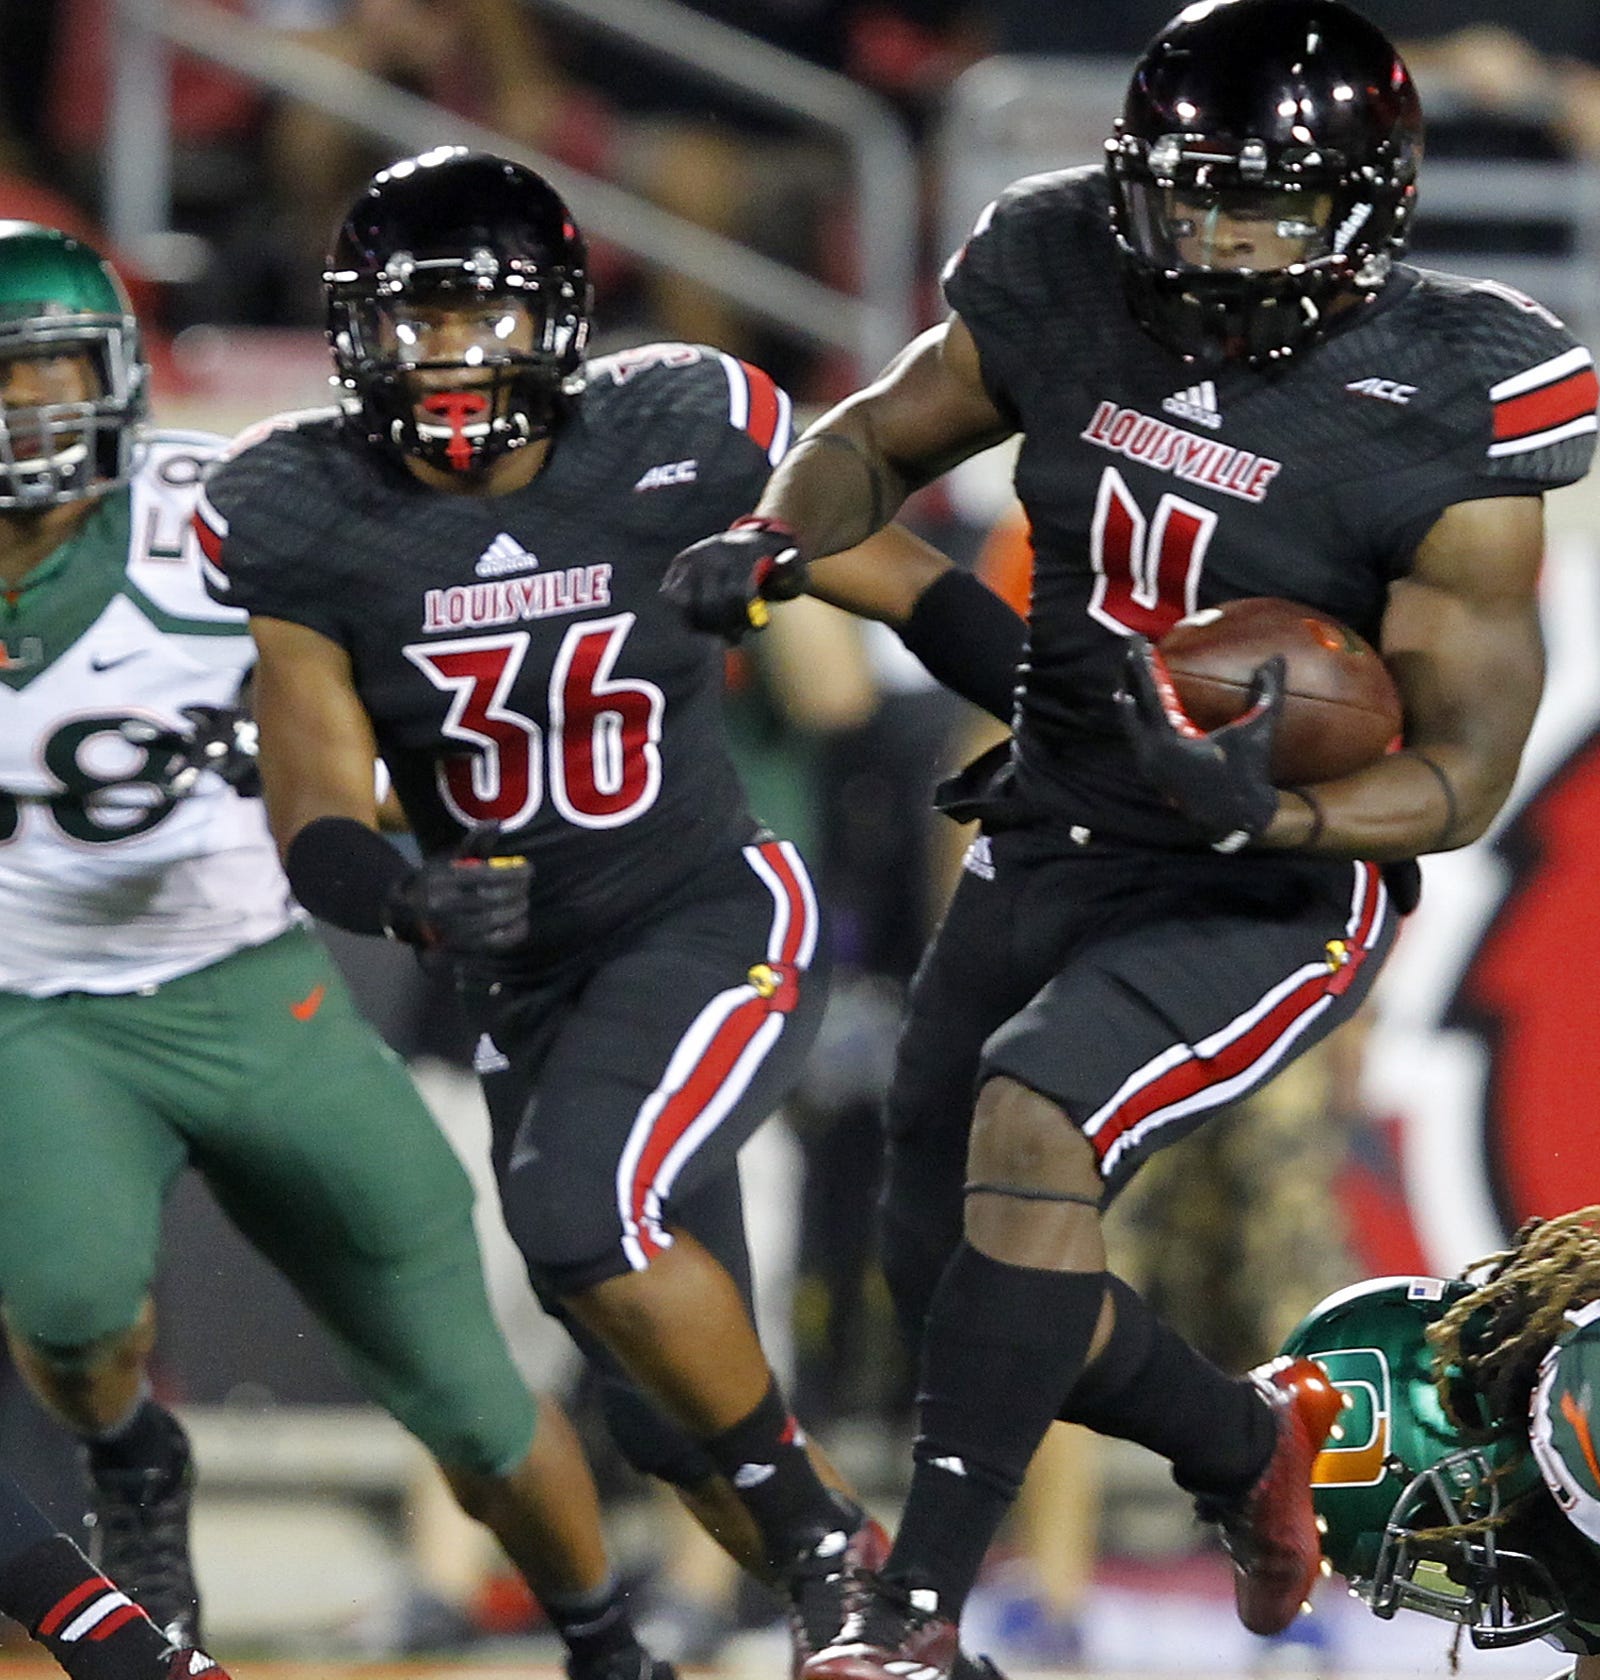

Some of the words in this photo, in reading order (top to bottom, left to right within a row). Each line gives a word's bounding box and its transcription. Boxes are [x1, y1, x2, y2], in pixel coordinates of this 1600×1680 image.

[1345, 378, 1419, 405] ACC
[634, 458, 699, 492] ACC
[1080, 400, 1282, 503] LOUISVILLE
[422, 563, 613, 634] LOUISVILLE
[1087, 465, 1219, 642] 4
[402, 611, 666, 833] 36
[0, 704, 203, 852] 8
